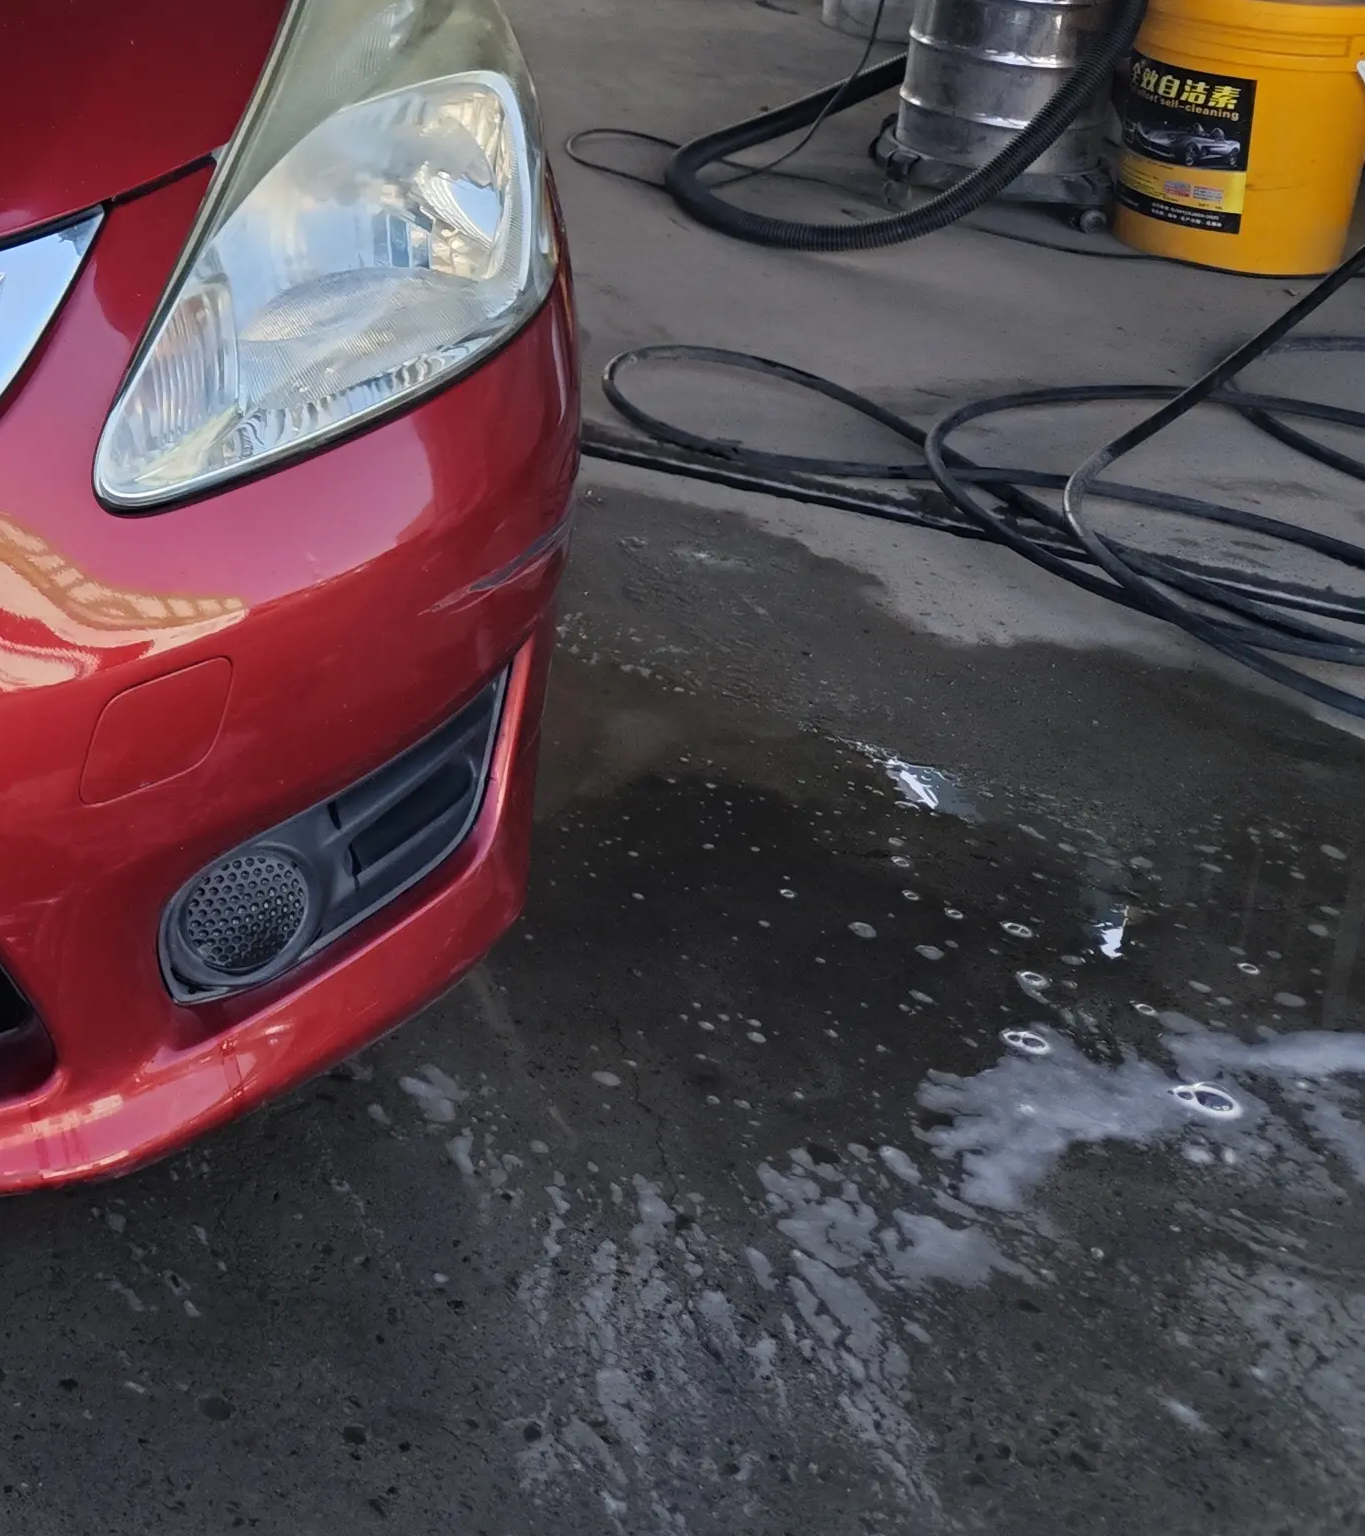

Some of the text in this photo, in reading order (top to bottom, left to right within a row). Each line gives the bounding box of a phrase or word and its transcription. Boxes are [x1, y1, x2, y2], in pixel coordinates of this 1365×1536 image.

[1131, 62, 1242, 110] 全效自洁素
